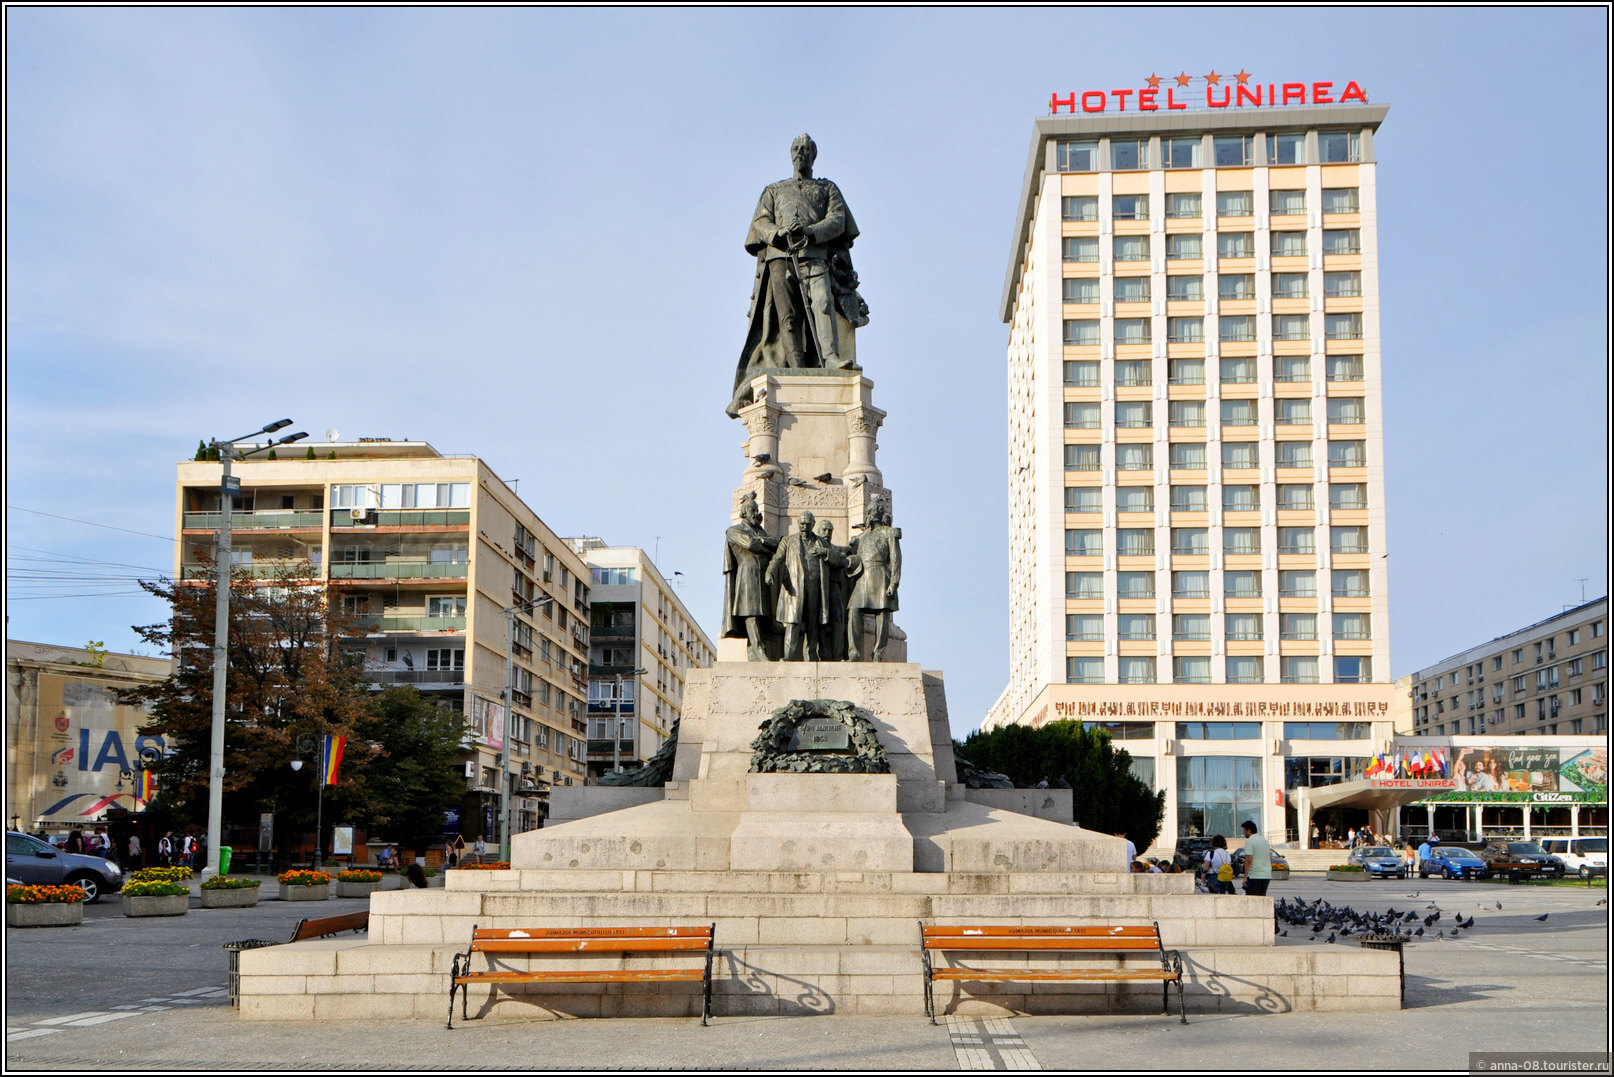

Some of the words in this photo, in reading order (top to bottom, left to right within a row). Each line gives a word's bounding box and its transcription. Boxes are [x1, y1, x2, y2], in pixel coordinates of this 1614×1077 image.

[1051, 87, 1187, 114] HOTEL
[1206, 80, 1367, 108] UNIREA
[1508, 750, 1524, 769] find
[1526, 754, 1542, 769] your
[1543, 753, 1558, 768] zen
[1380, 780, 1413, 788] HOTEL
[1417, 780, 1456, 788] UNIREA
[1533, 792, 1573, 802] CitiZen
